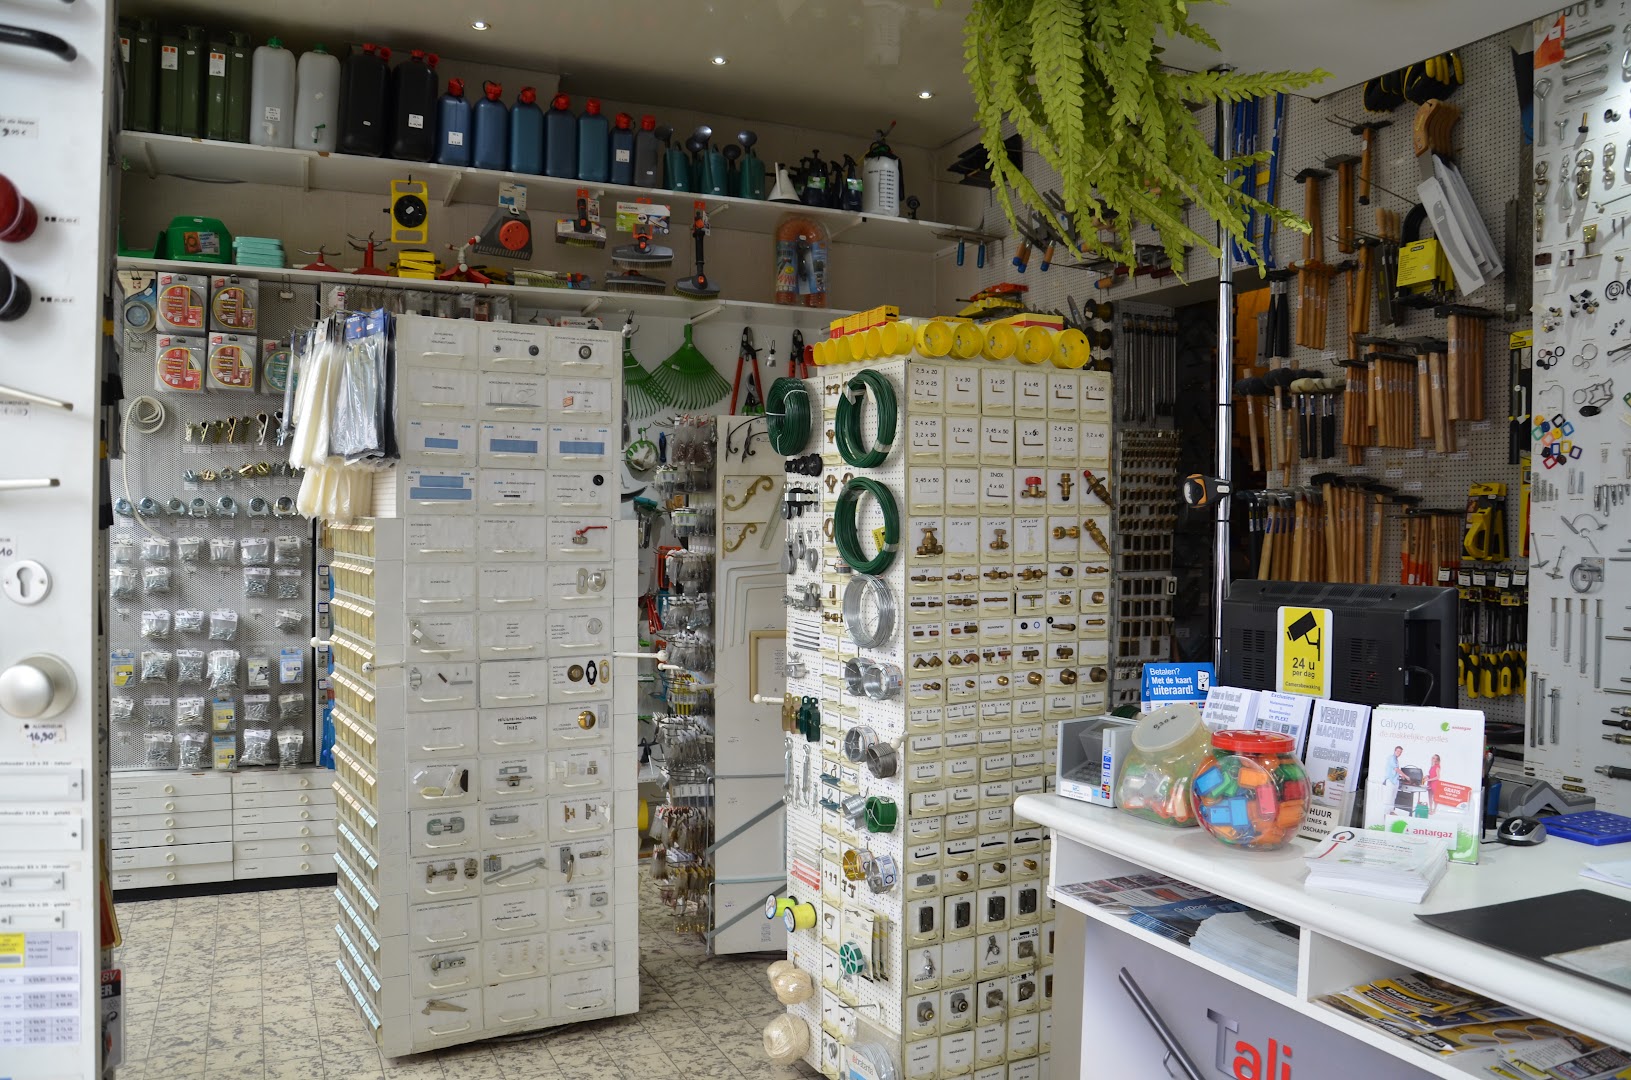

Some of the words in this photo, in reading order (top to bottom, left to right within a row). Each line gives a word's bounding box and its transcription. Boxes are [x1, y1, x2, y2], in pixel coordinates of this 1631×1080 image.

[1292, 657, 1305, 669] 24
[1309, 662, 1315, 670] u
[1304, 670, 1315, 679] dag
[1153, 685, 1194, 695] uiteraard!
[1271, 693, 1295, 701] Exclusieve
[1320, 706, 1358, 727] VERHUUR
[1381, 719, 1415, 731] Calypso,
[1316, 724, 1354, 741] MACHINES
[1413, 826, 1453, 839] antargaz
[1174, 904, 1208, 913] OutDoor
